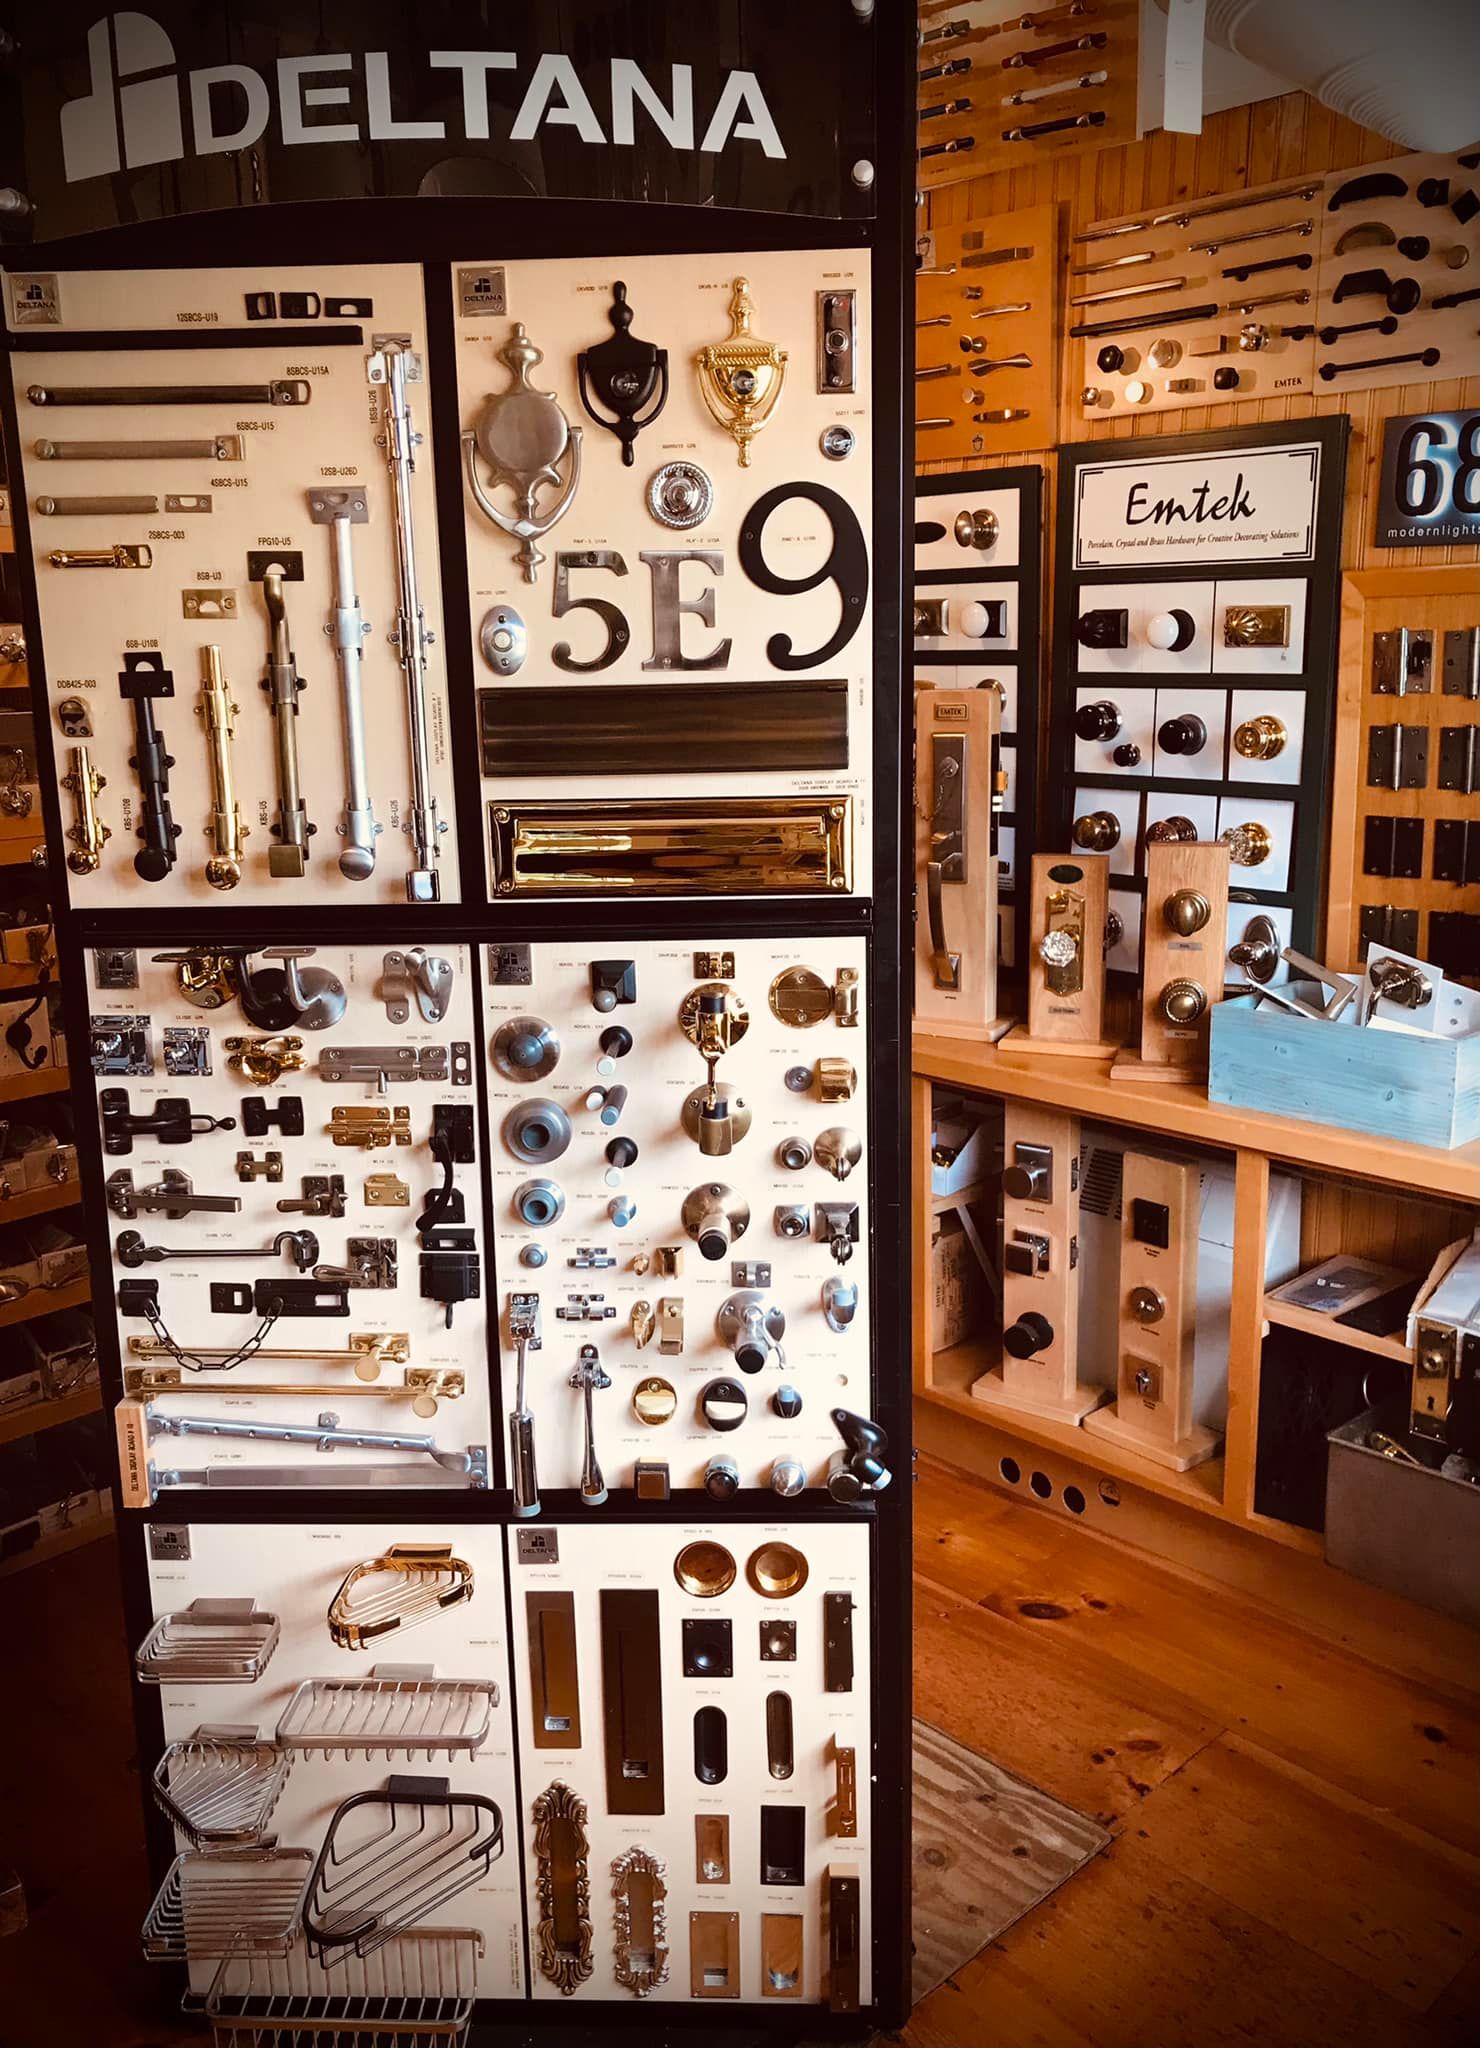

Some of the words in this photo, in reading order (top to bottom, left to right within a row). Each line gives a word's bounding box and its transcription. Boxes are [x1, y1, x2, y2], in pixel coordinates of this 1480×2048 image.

[189, 50, 788, 159] DELTANA
[17, 300, 55, 309] DELTANA
[464, 295, 503, 303] DELTANA
[1274, 377, 1302, 388] EMTEK
[1126, 473, 1256, 526] Emtek
[1116, 537, 1136, 549] Crystal
[1137, 537, 1149, 546] and
[1150, 536, 1165, 546] Brass
[1166, 535, 1195, 545] Hardware
[1196, 534, 1206, 546] for
[1207, 532, 1234, 543] Creative
[1234, 531, 1268, 543] Decorating
[1270, 530, 1300, 540] Solutions
